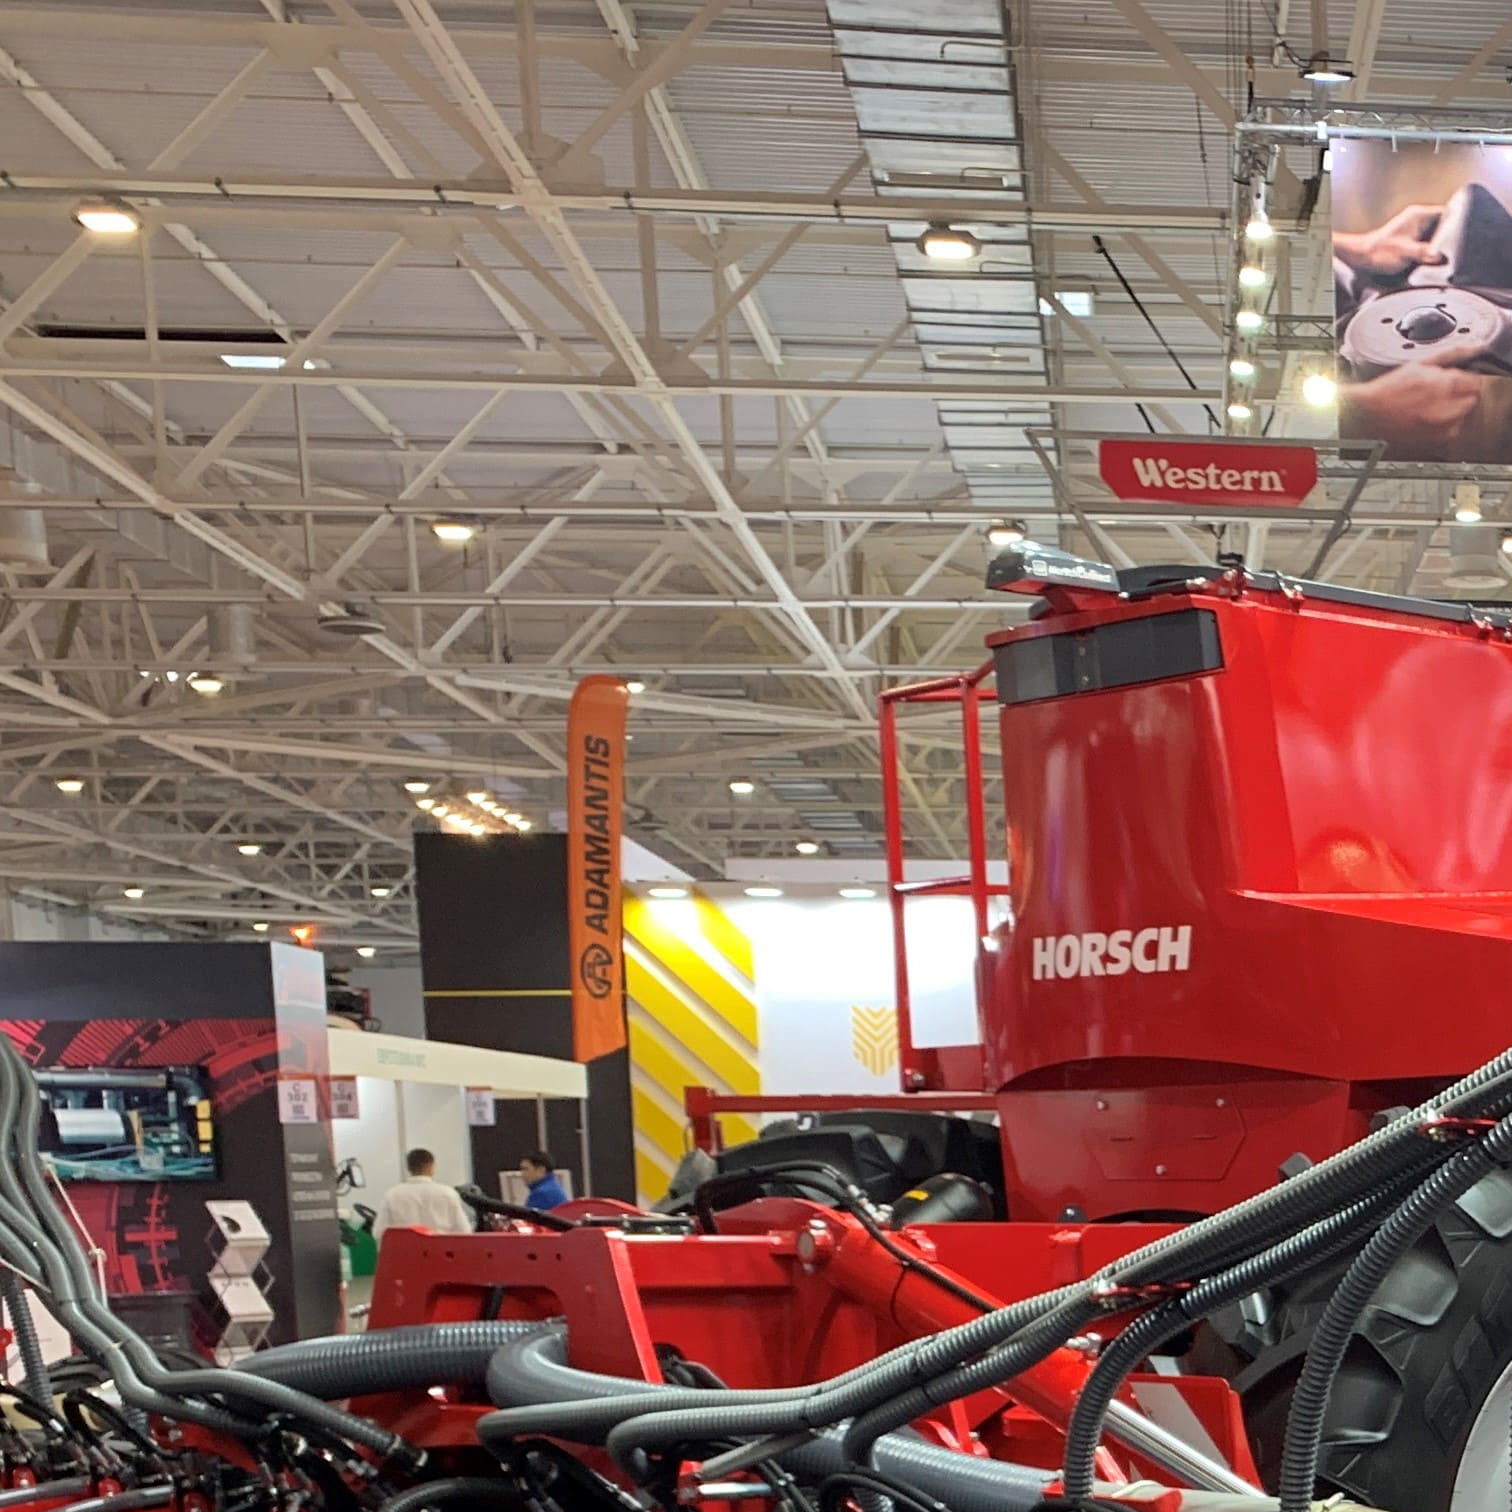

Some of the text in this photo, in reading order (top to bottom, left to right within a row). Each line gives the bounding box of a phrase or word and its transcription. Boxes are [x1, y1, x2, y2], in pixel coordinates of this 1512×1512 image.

[1132, 457, 1284, 492] Western
[584, 735, 611, 936] ADAMANTIS
[1033, 925, 1192, 981] HORSCH
